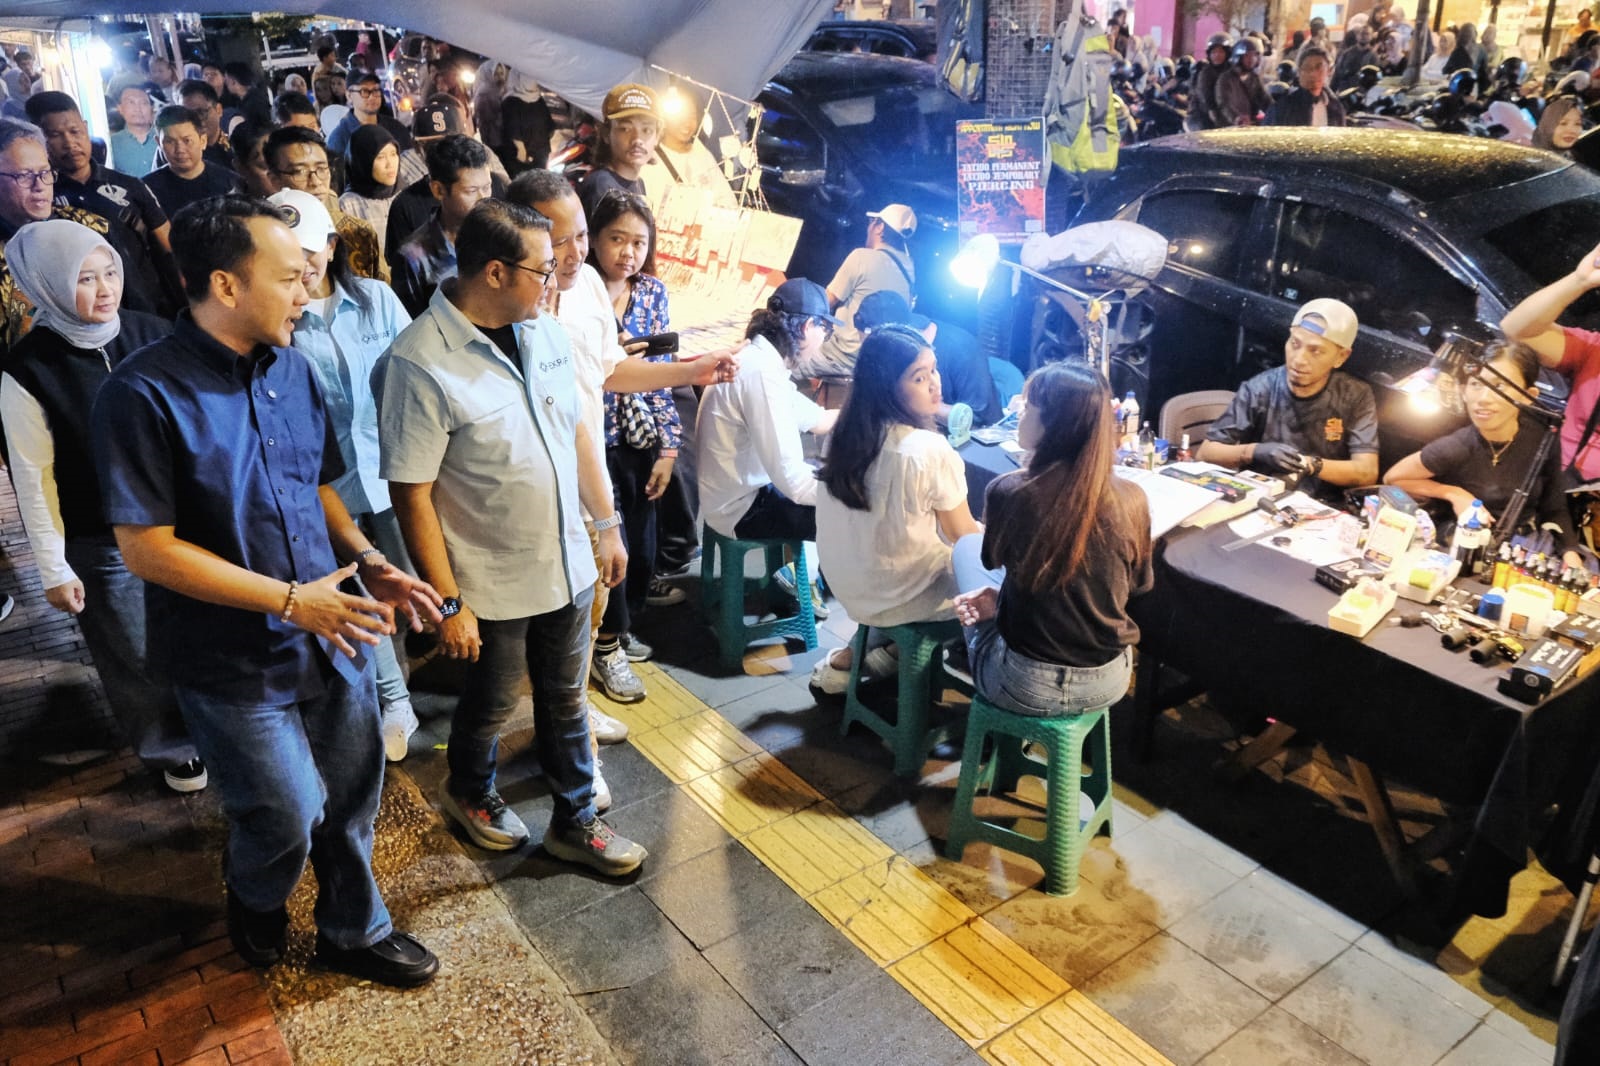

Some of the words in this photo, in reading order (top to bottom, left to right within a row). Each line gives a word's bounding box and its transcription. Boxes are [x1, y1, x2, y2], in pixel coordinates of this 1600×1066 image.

[432, 111, 446, 132] S
[961, 163, 990, 172] TATTOO
[992, 161, 1041, 171] PERMANENT
[962, 172, 991, 181] TATTOO
[992, 171, 1041, 180] TEMPORARY
[968, 181, 1034, 191] PIERCING
